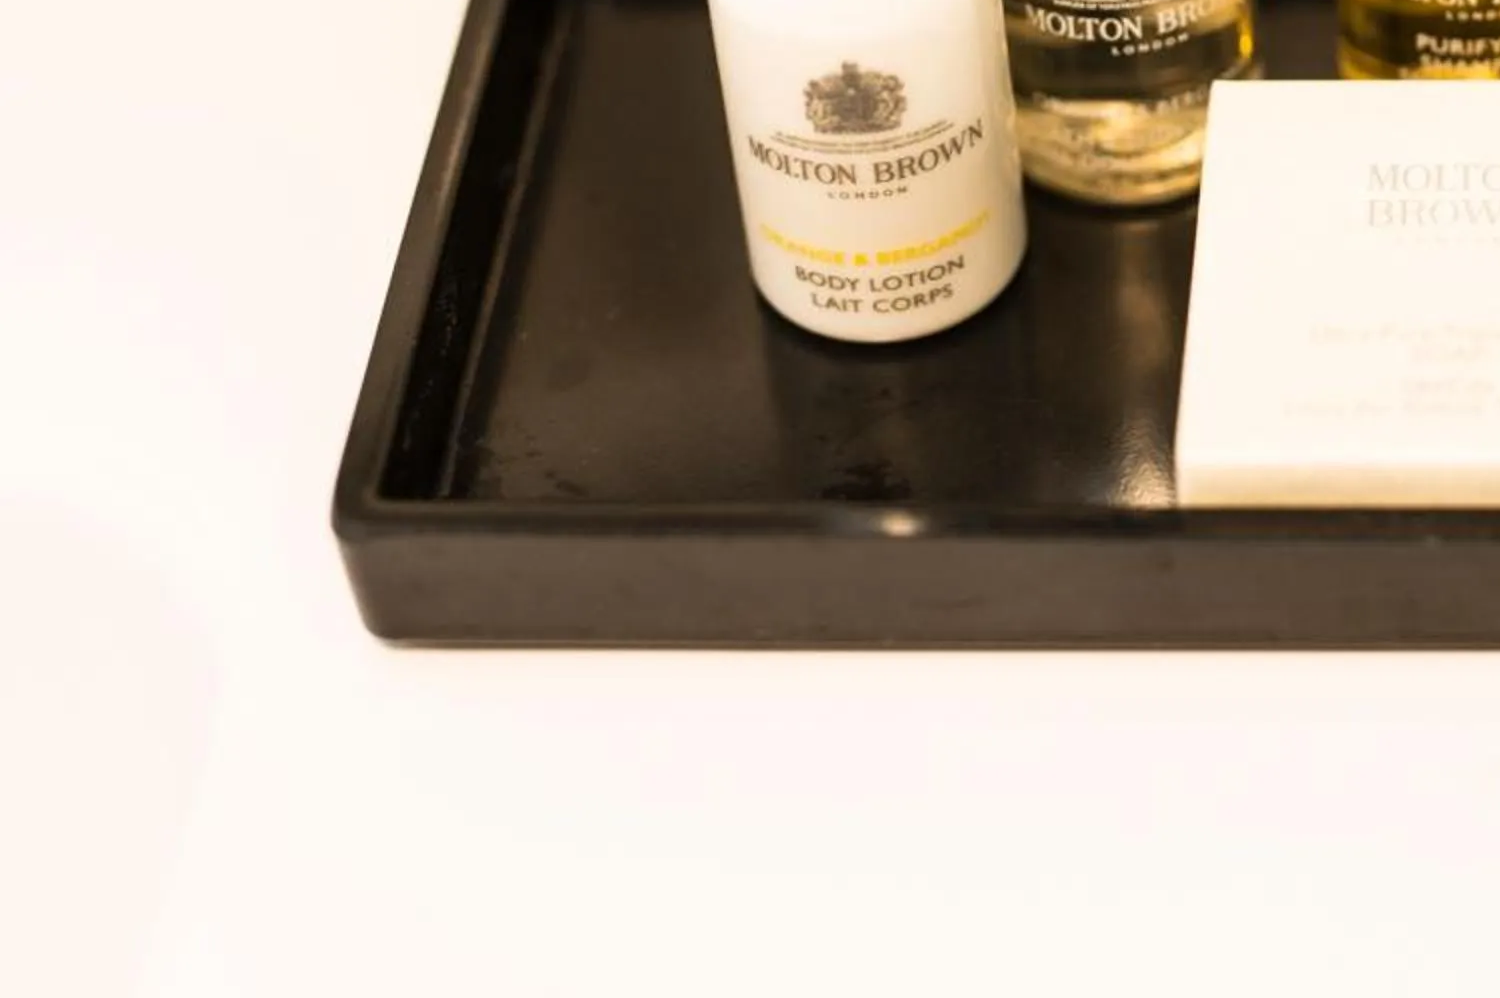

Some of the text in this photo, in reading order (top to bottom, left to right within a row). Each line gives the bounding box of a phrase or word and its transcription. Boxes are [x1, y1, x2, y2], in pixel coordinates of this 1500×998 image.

[1025, 4, 1143, 43] MOLTON
[748, 133, 858, 186] MOLTON
[873, 117, 985, 184] BROWN
[827, 186, 908, 200] LONDON
[795, 254, 965, 293] BODY LOTION
[811, 283, 954, 314] LAIT CORPS
